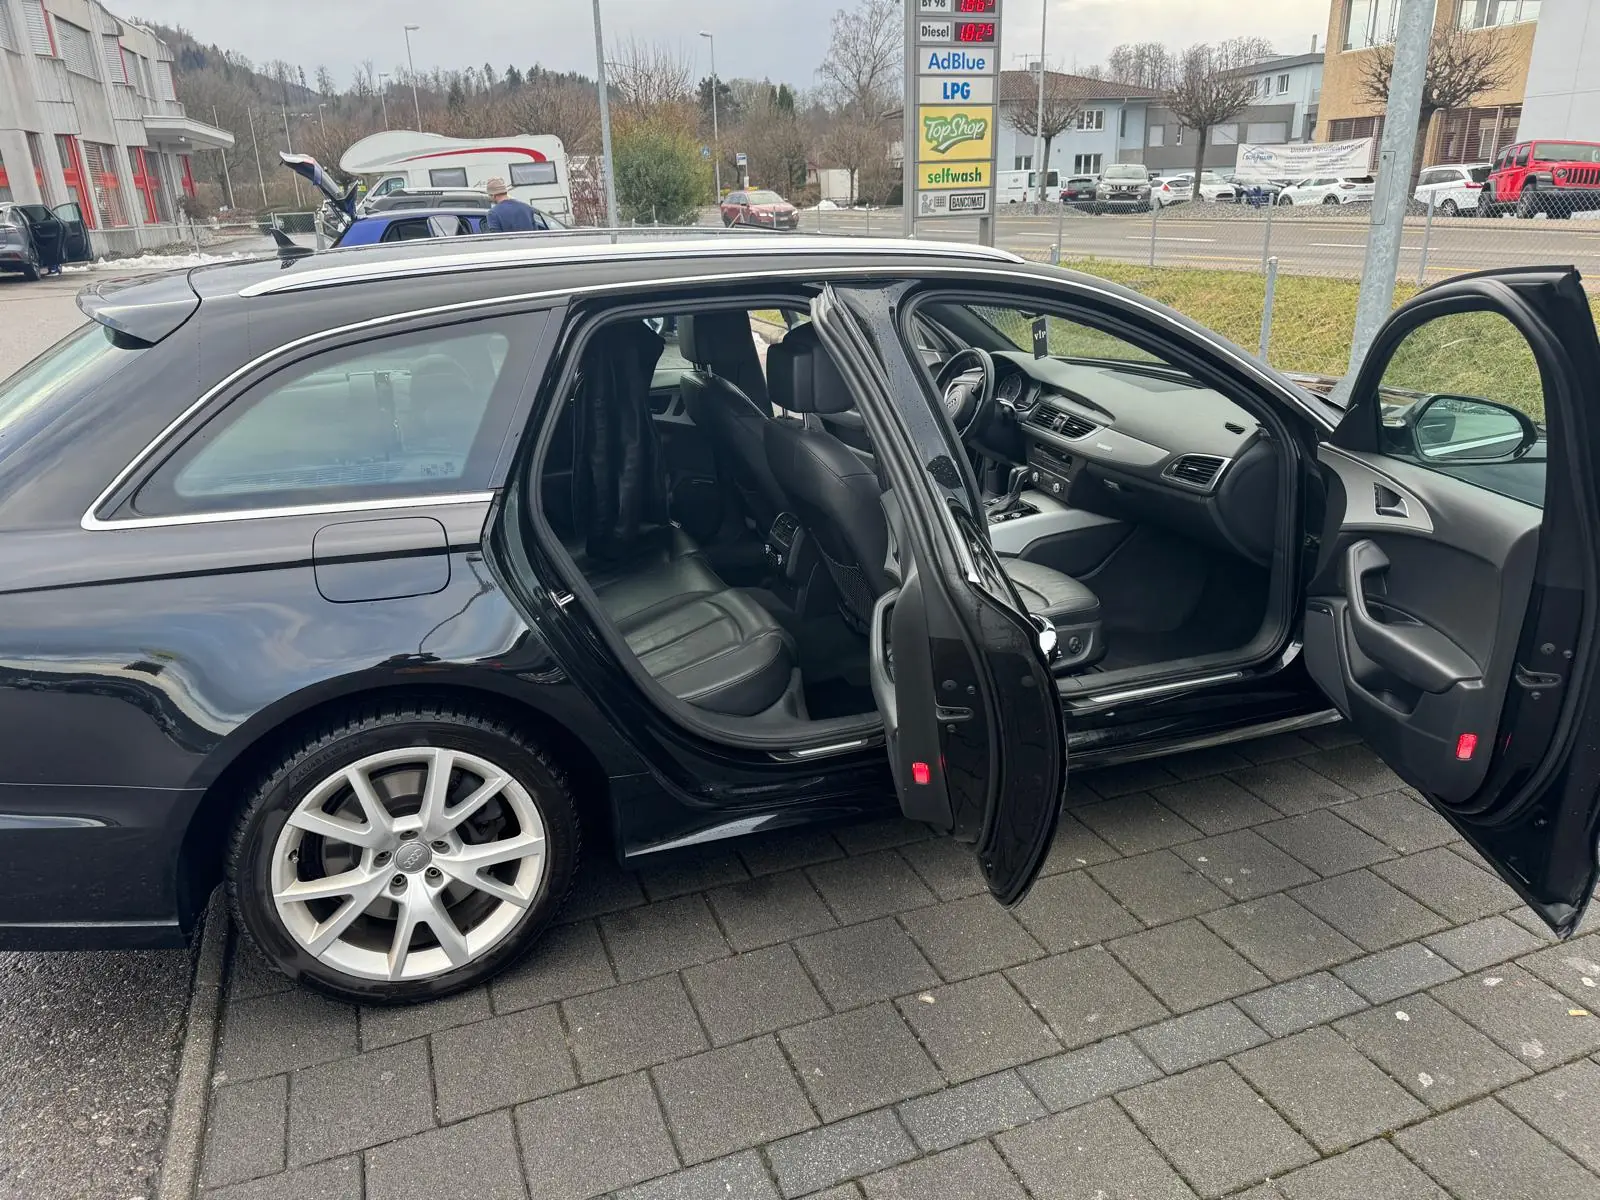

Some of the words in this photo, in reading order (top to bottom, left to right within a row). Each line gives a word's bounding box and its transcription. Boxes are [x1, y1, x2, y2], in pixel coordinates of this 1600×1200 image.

[921, 25, 949, 37] Diesel
[928, 52, 985, 70] AdBlue
[943, 82, 971, 100] LPG
[928, 167, 982, 183] selfwash
[952, 196, 983, 208] BANCOMAT
